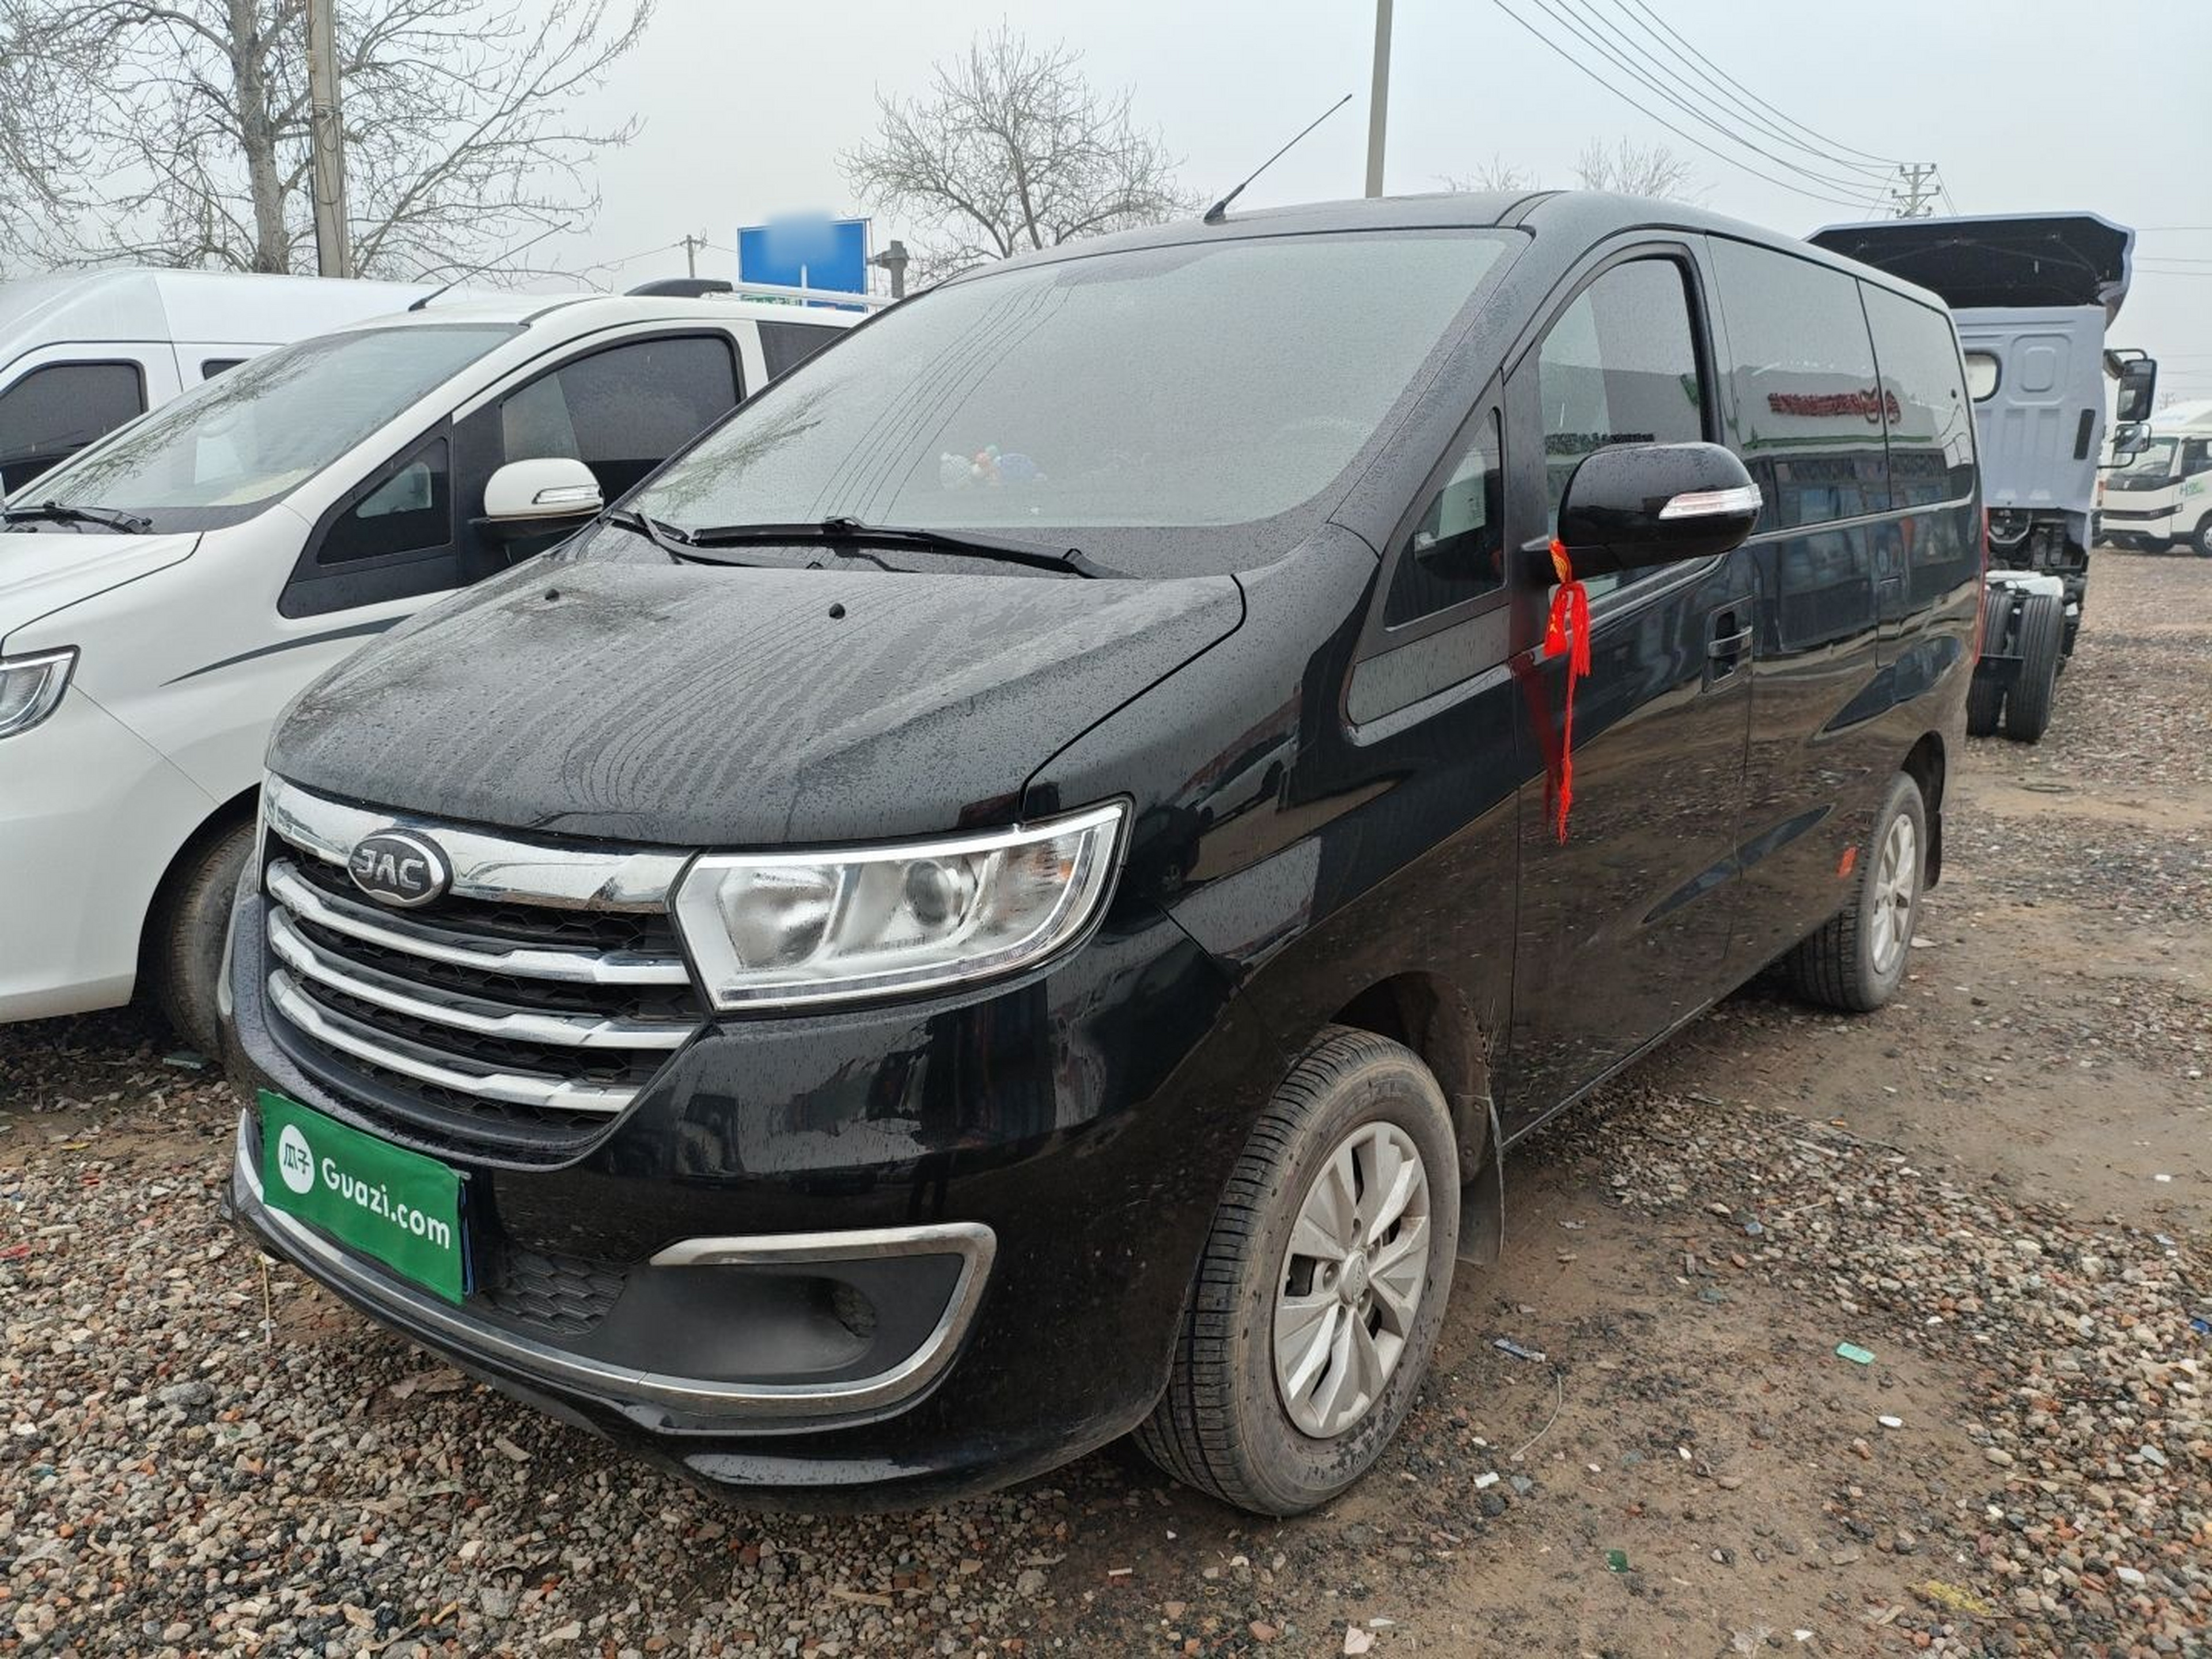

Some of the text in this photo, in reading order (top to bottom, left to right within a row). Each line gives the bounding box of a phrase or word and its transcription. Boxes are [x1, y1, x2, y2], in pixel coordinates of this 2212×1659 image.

[355, 848, 425, 891] JAC
[283, 1142, 310, 1175] 瓜子
[321, 1157, 450, 1250] Guazi.com
